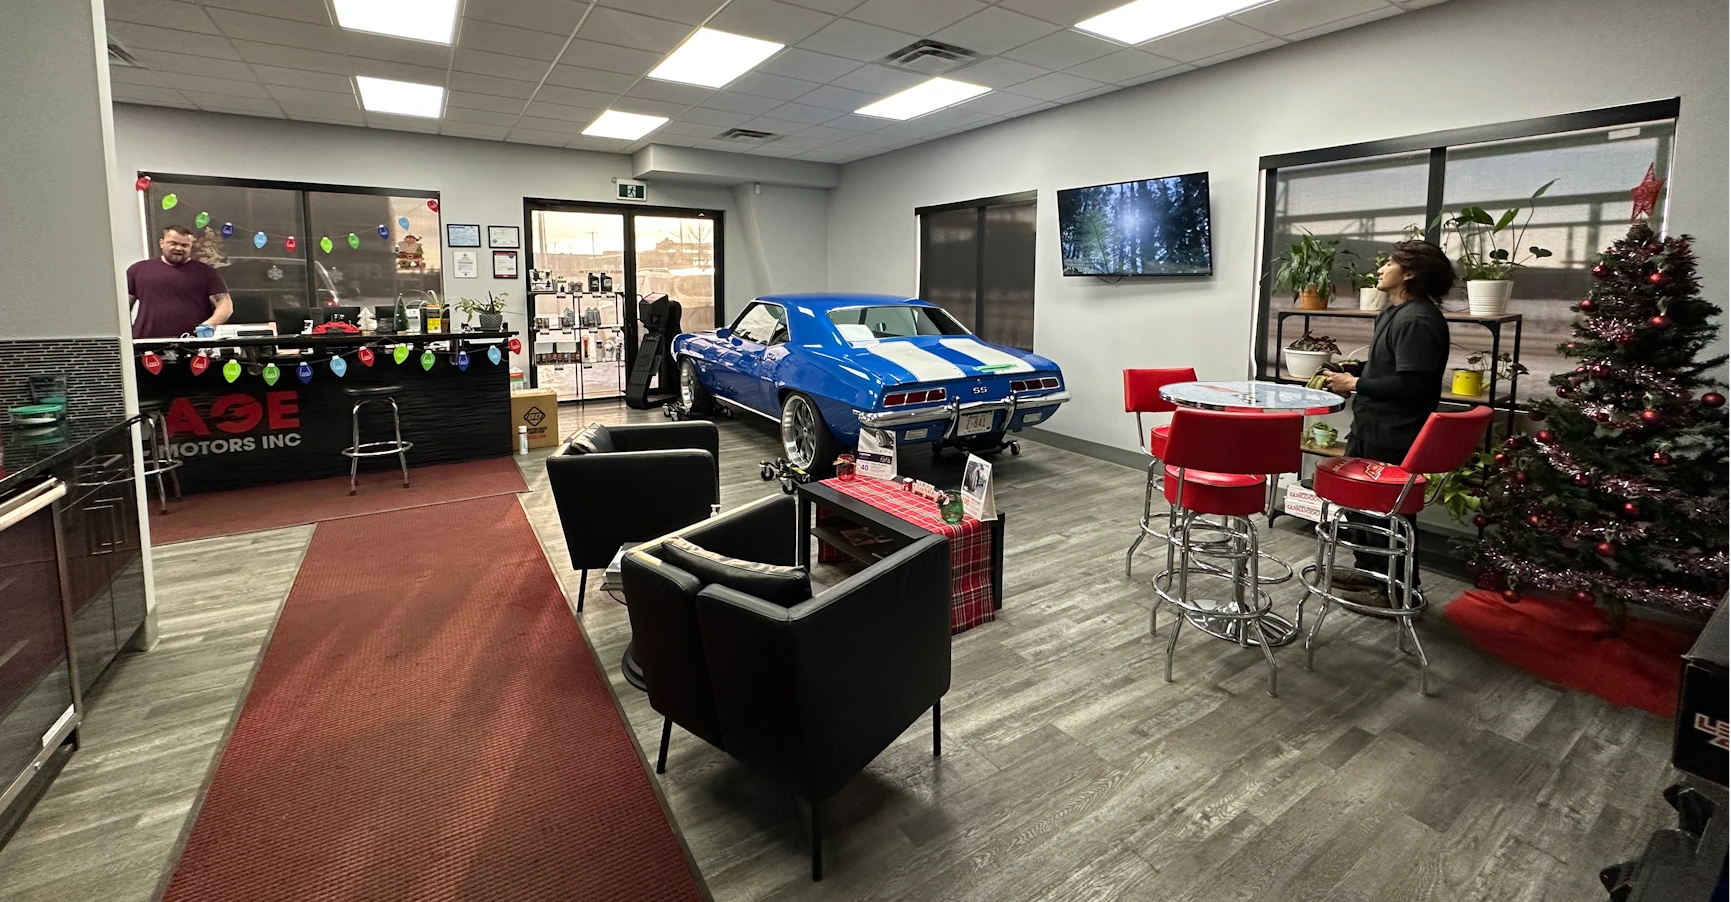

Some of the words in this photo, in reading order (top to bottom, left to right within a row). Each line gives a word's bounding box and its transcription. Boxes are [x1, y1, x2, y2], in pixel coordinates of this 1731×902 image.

[972, 386, 988, 394] SS
[159, 437, 256, 459] MOTORS
[262, 433, 302, 449] INC
